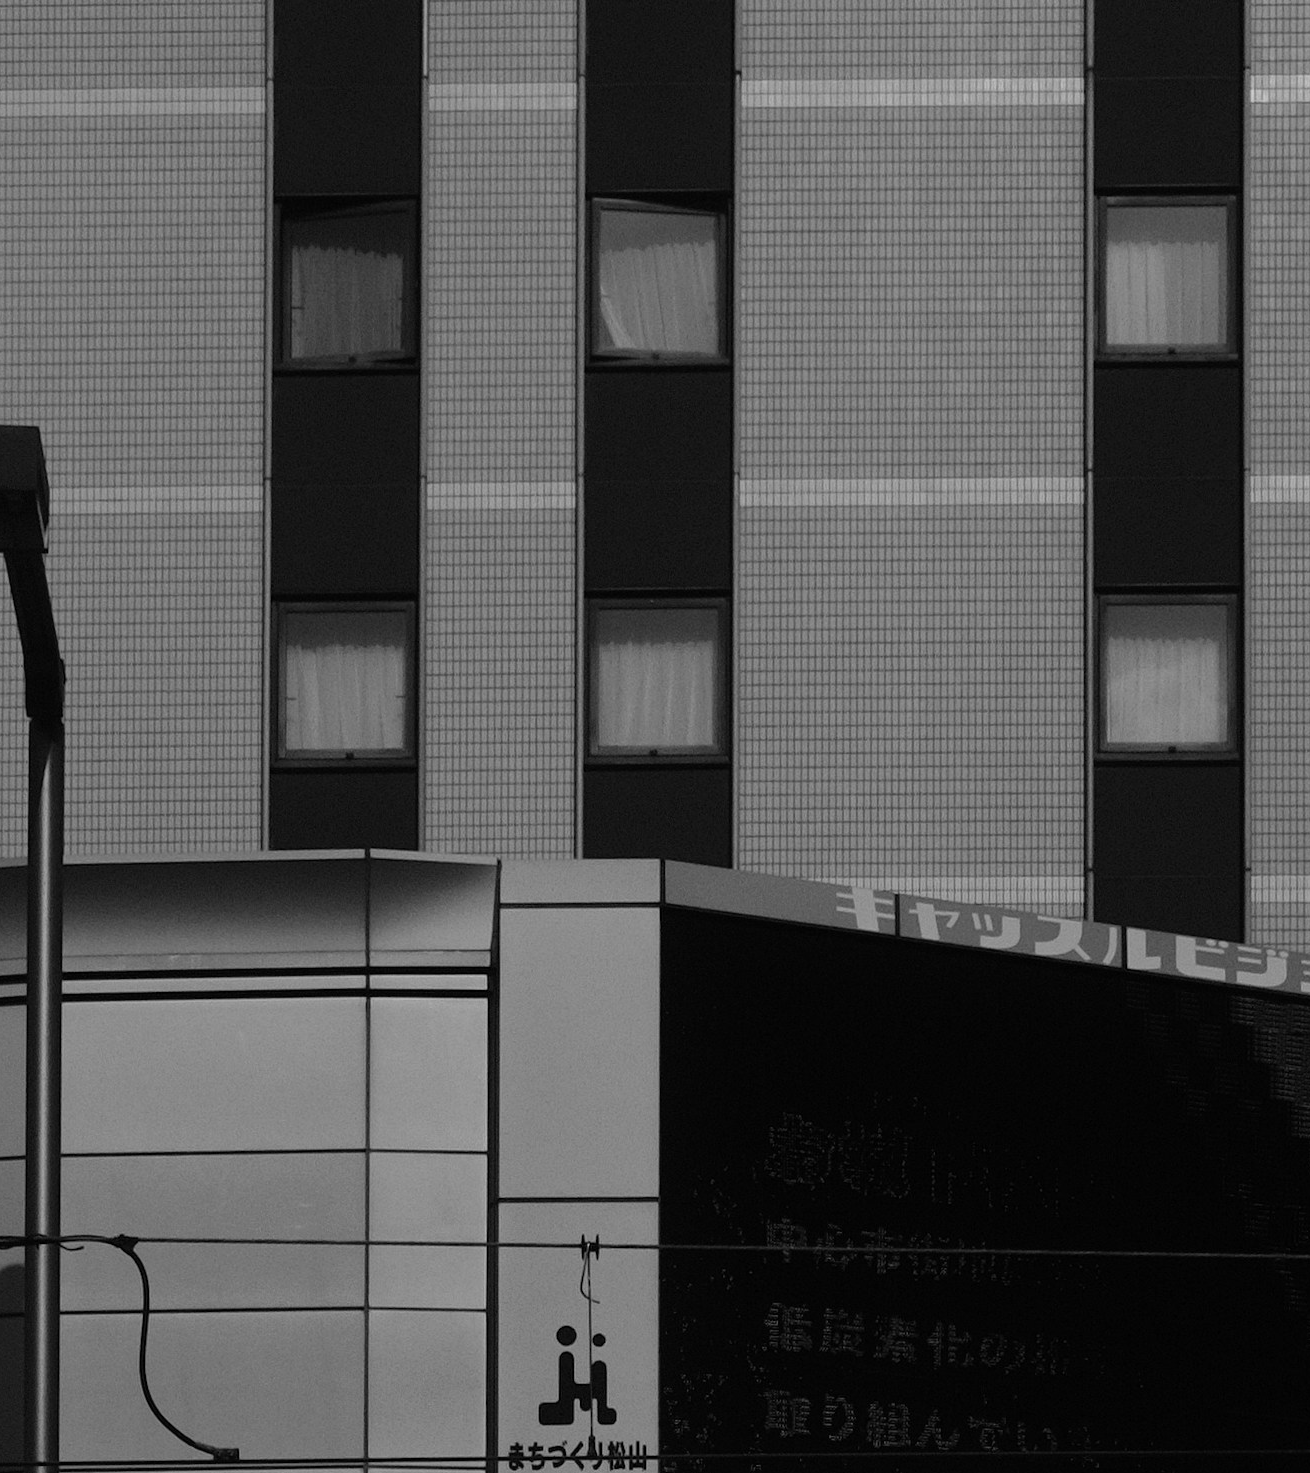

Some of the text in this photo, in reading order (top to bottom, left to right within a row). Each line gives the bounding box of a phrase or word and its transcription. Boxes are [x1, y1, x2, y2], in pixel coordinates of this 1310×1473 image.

[507, 1440, 648, 1471] まちづくり松山
